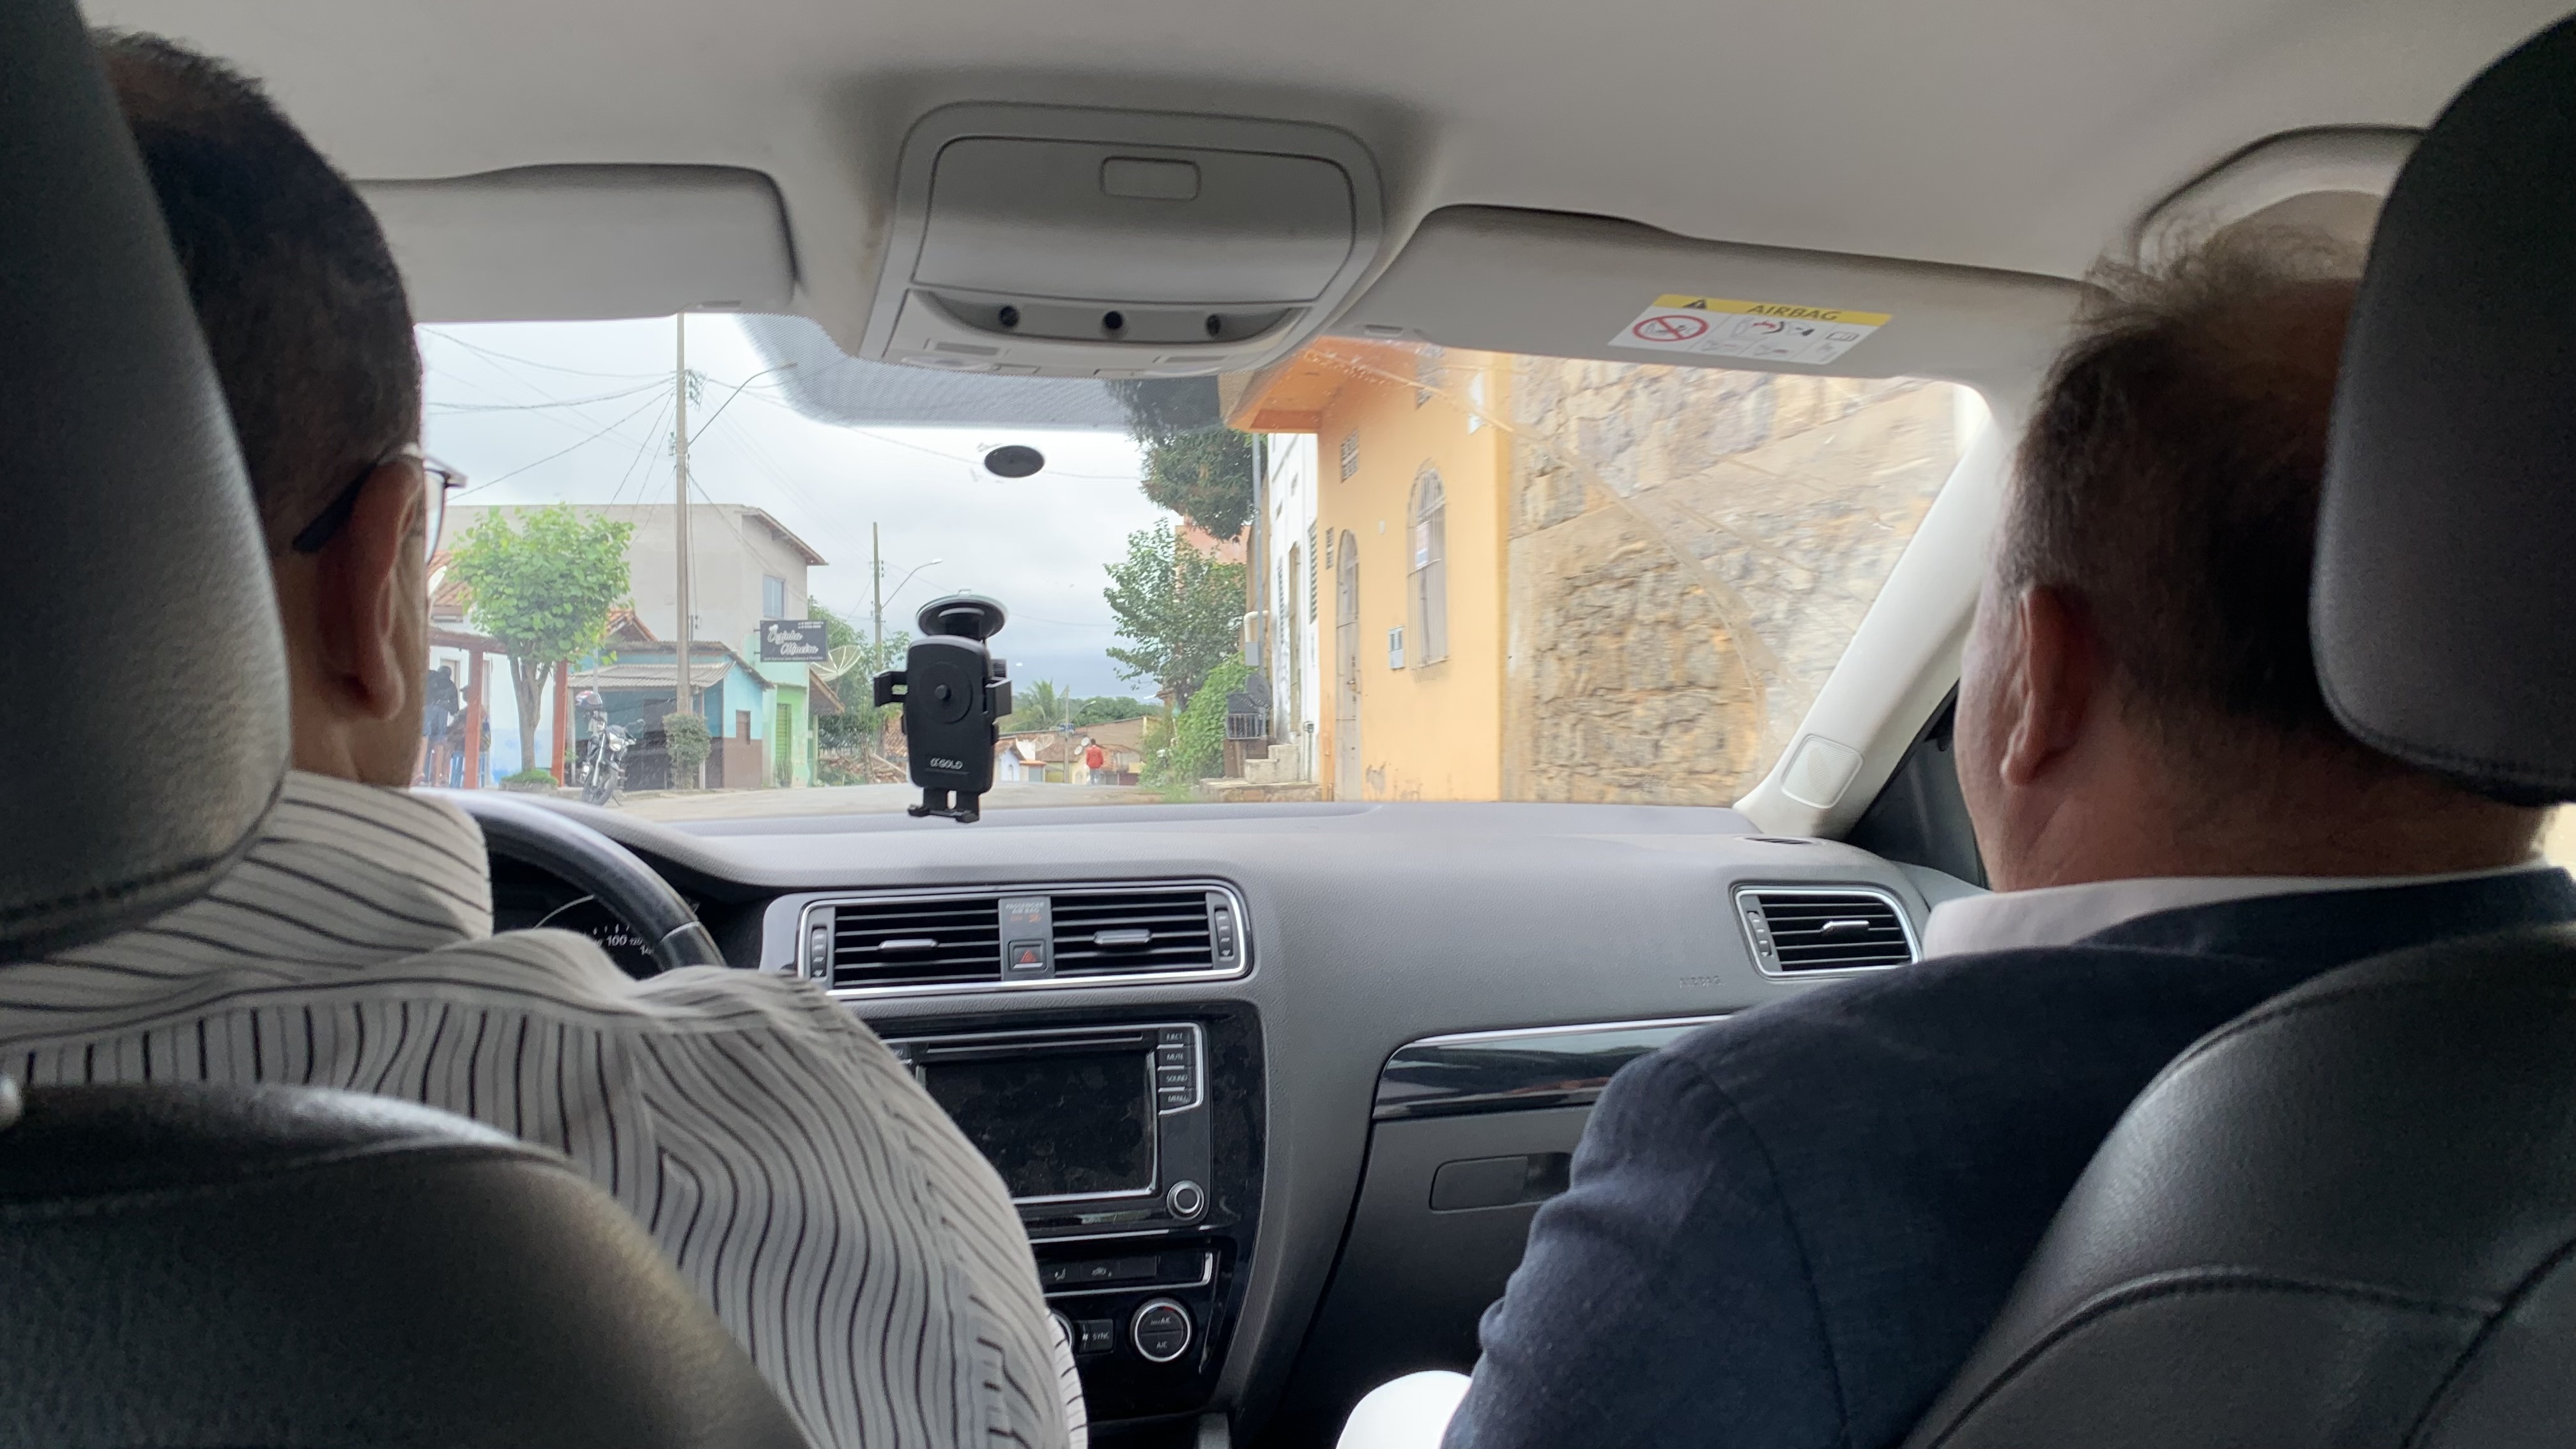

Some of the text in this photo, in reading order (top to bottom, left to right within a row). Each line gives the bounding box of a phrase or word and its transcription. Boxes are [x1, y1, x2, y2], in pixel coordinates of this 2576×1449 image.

[1747, 305, 1842, 320] AIRBAG
[767, 629, 803, 645] Cozinha
[781, 641, 819, 656] Mineira
[606, 934, 628, 947] 100
[1167, 1052, 1184, 1061] MUTE
[1166, 1074, 1188, 1084] SOUND
